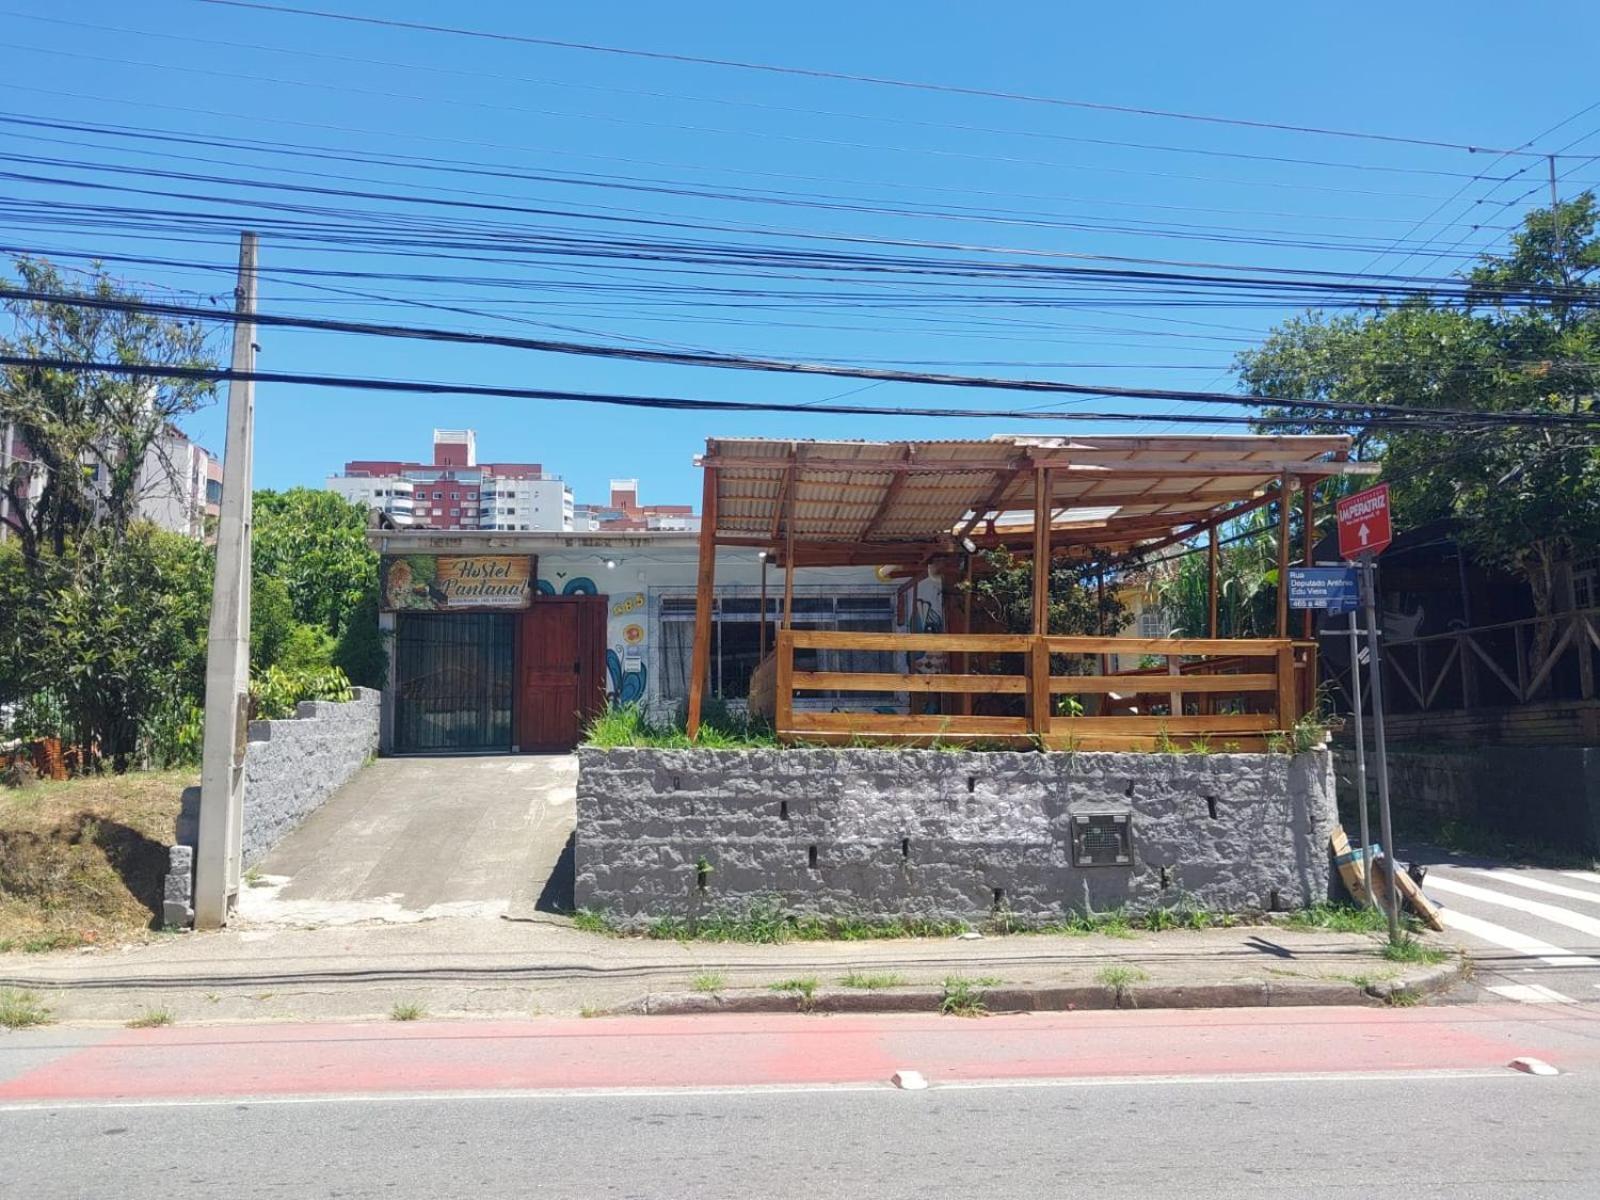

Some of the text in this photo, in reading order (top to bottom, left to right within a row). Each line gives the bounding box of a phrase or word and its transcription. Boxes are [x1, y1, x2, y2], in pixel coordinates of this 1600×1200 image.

[1340, 494, 1386, 521] IMPERATRIZ
[442, 577, 528, 597] Pantanal
[1291, 579, 1326, 587] Deputado
[1291, 587, 1328, 595] Edu Vieira
